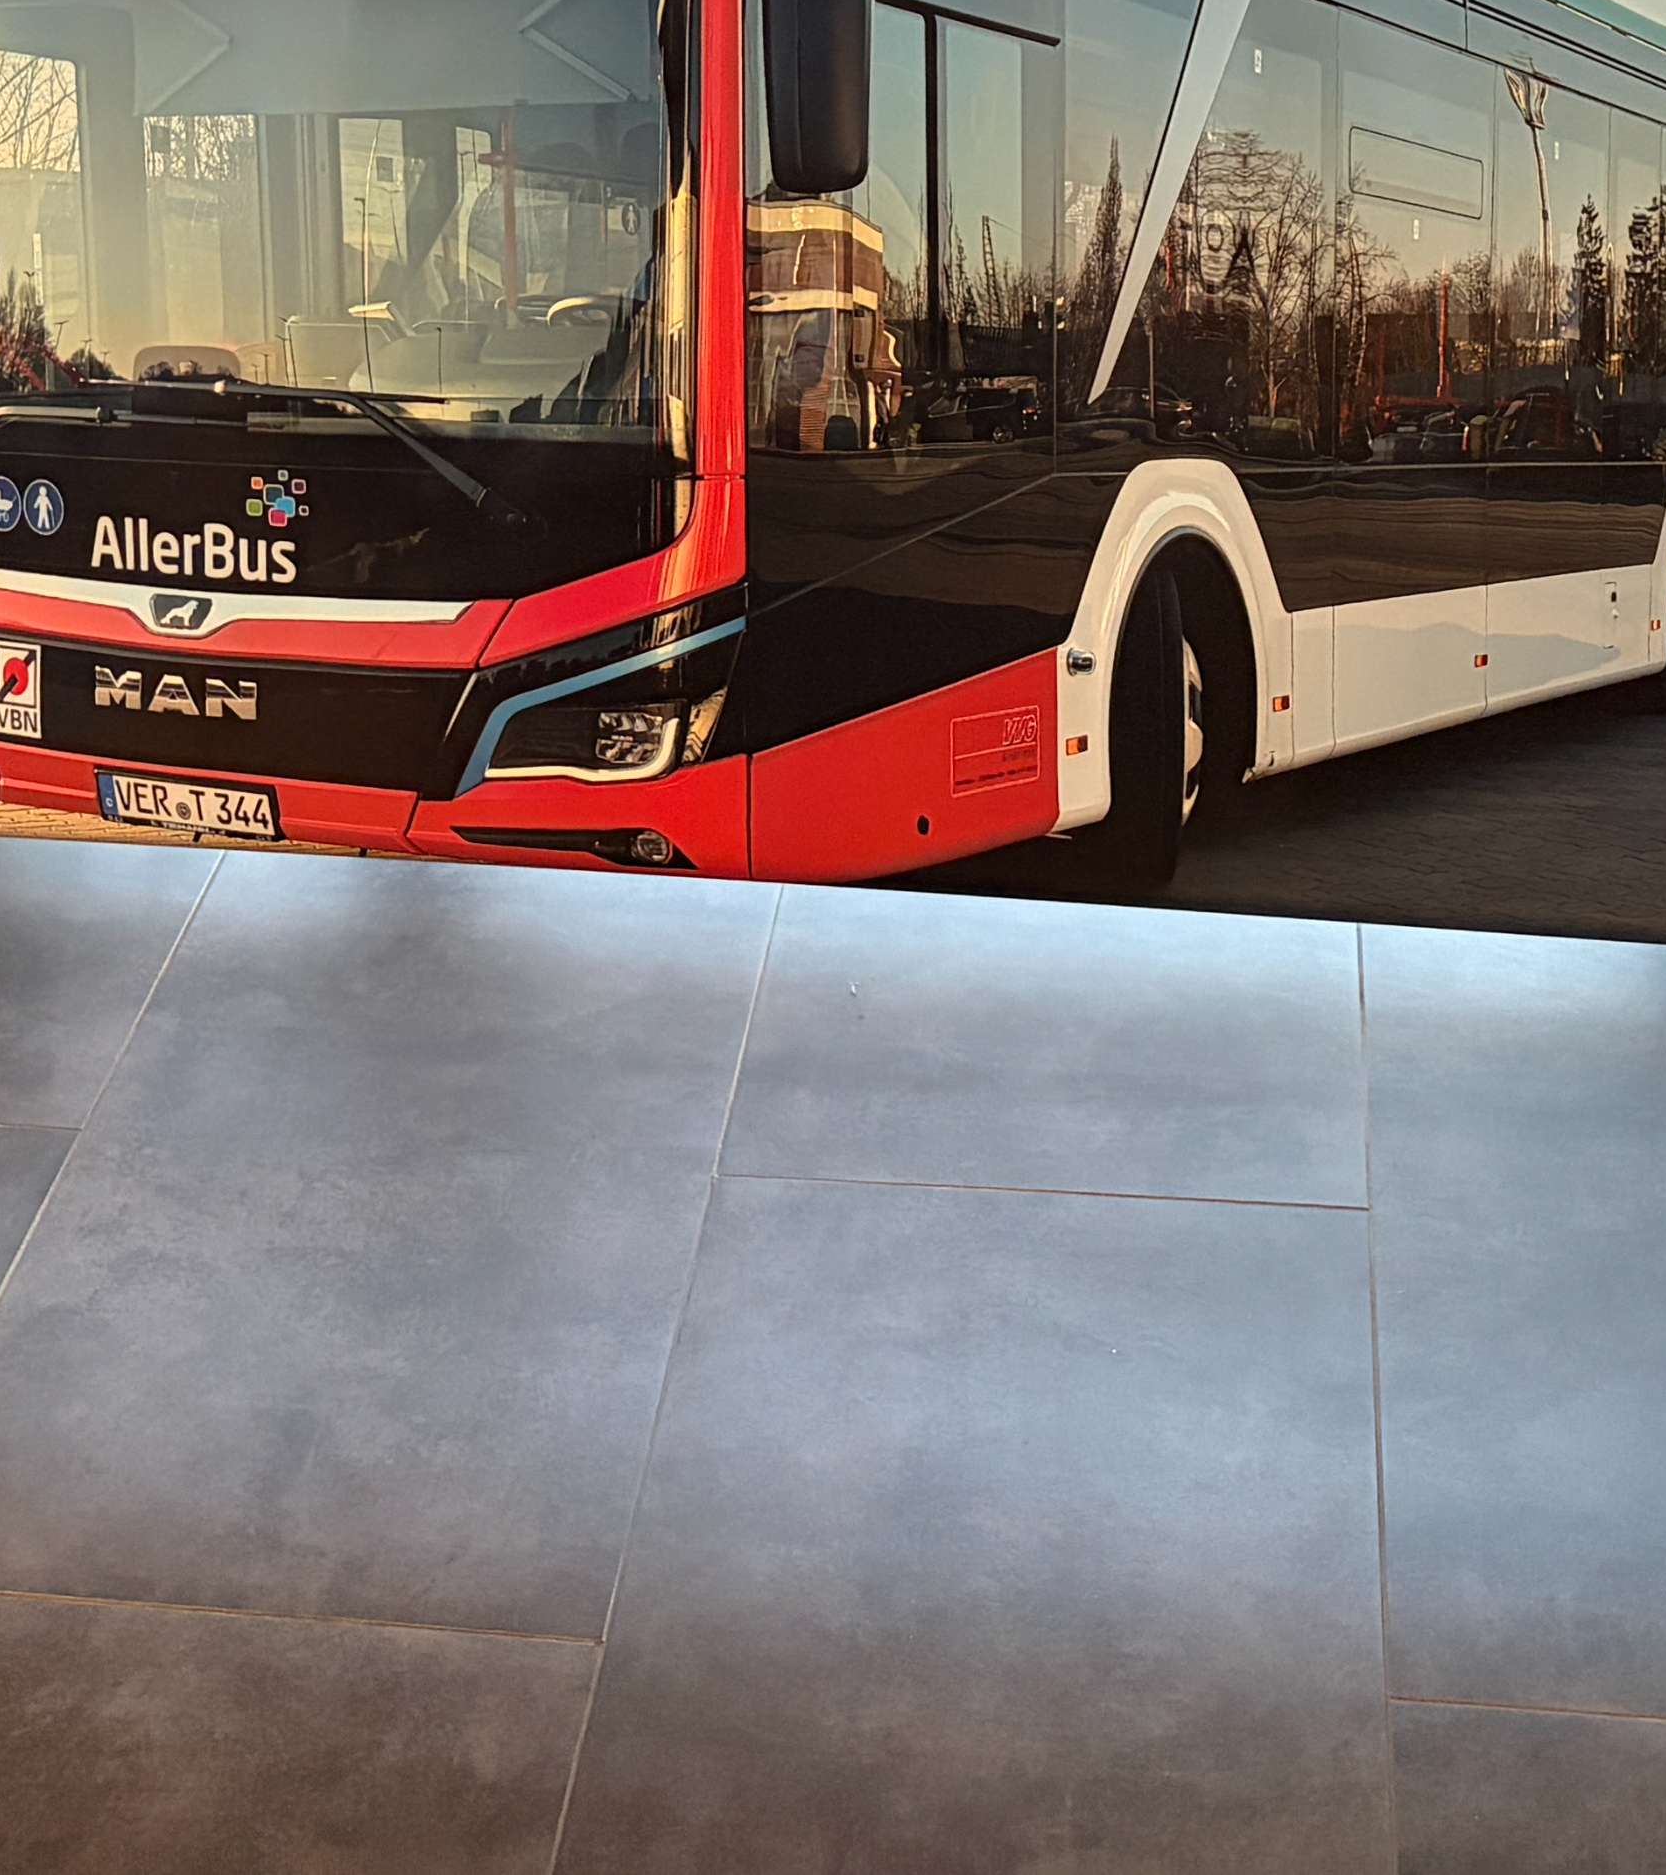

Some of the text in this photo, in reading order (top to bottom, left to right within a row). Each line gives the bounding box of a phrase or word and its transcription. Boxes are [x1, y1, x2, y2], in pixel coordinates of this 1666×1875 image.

[91, 516, 297, 583] AllerBus
[94, 665, 258, 720] MAN
[115, 779, 172, 817] VER
[189, 789, 206, 821] T
[213, 792, 270, 829] 344
